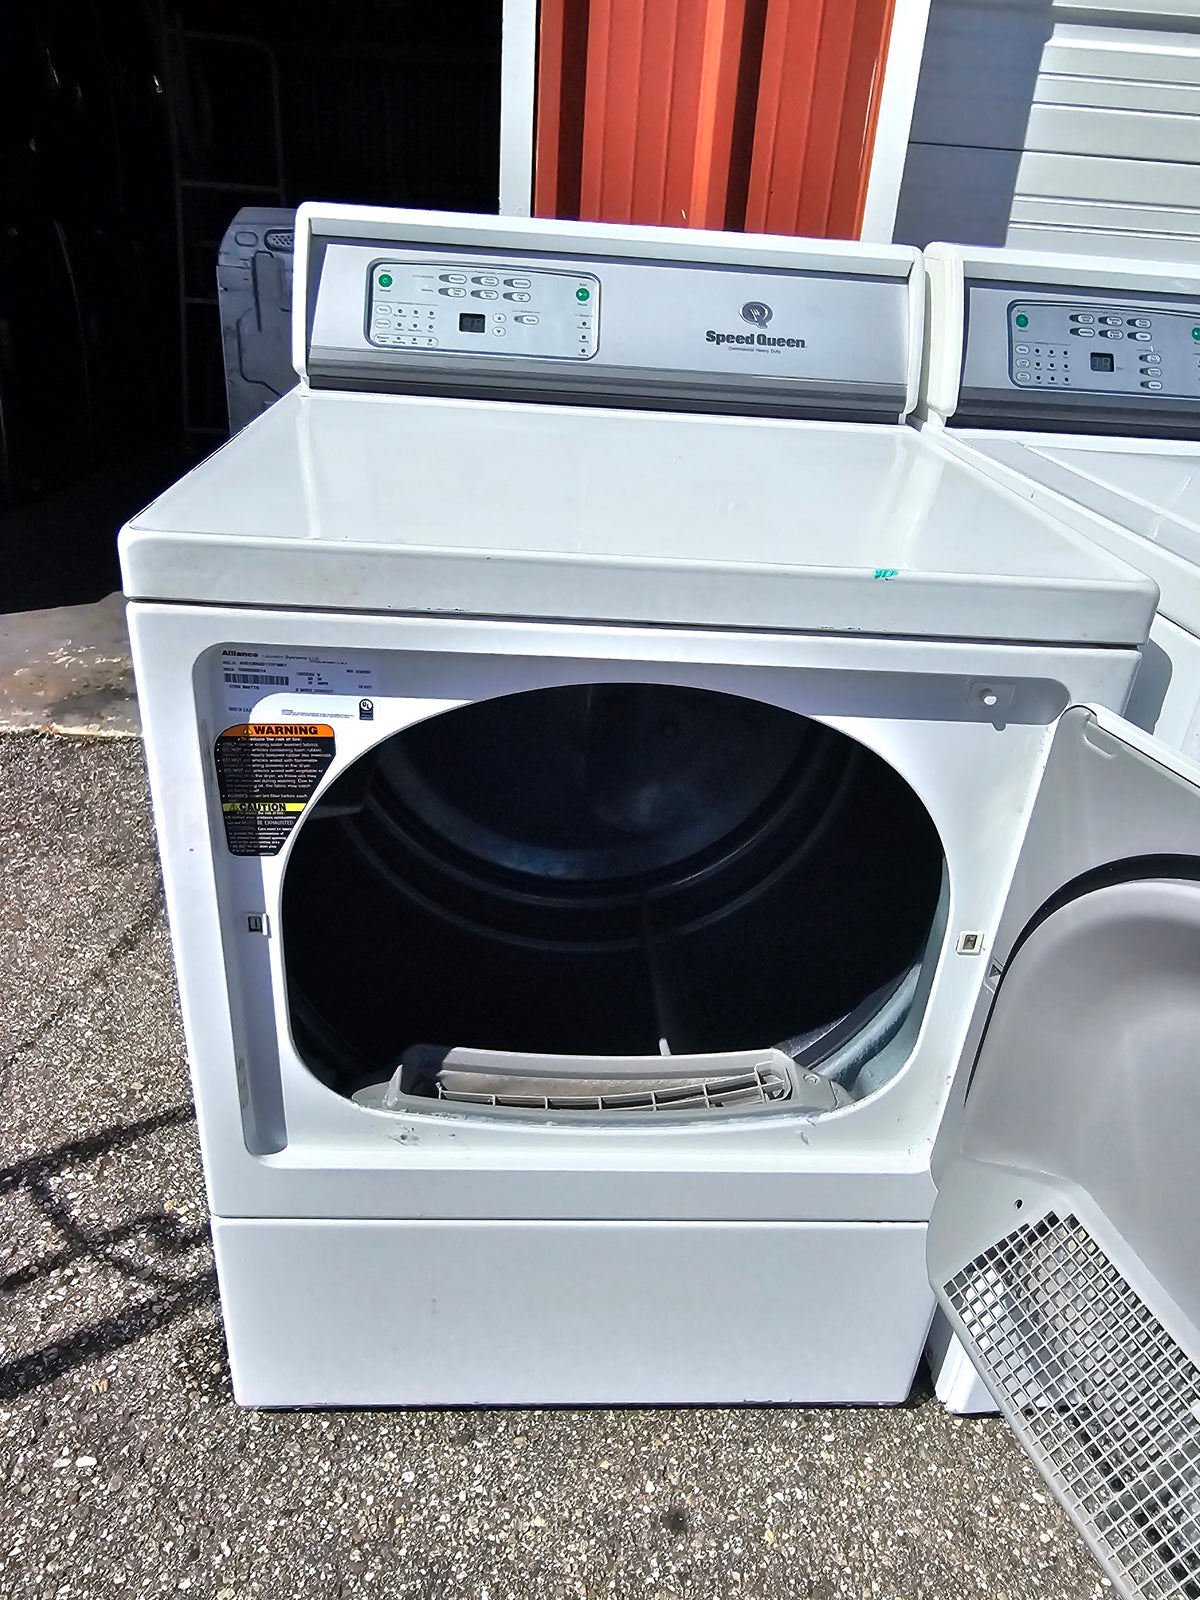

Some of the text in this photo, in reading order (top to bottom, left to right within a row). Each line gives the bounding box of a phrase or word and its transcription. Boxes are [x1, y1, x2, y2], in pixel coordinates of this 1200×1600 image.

[706, 330, 806, 348] Speed Queen
[253, 726, 318, 735] WARNING
[240, 803, 286, 812] CAUTION
